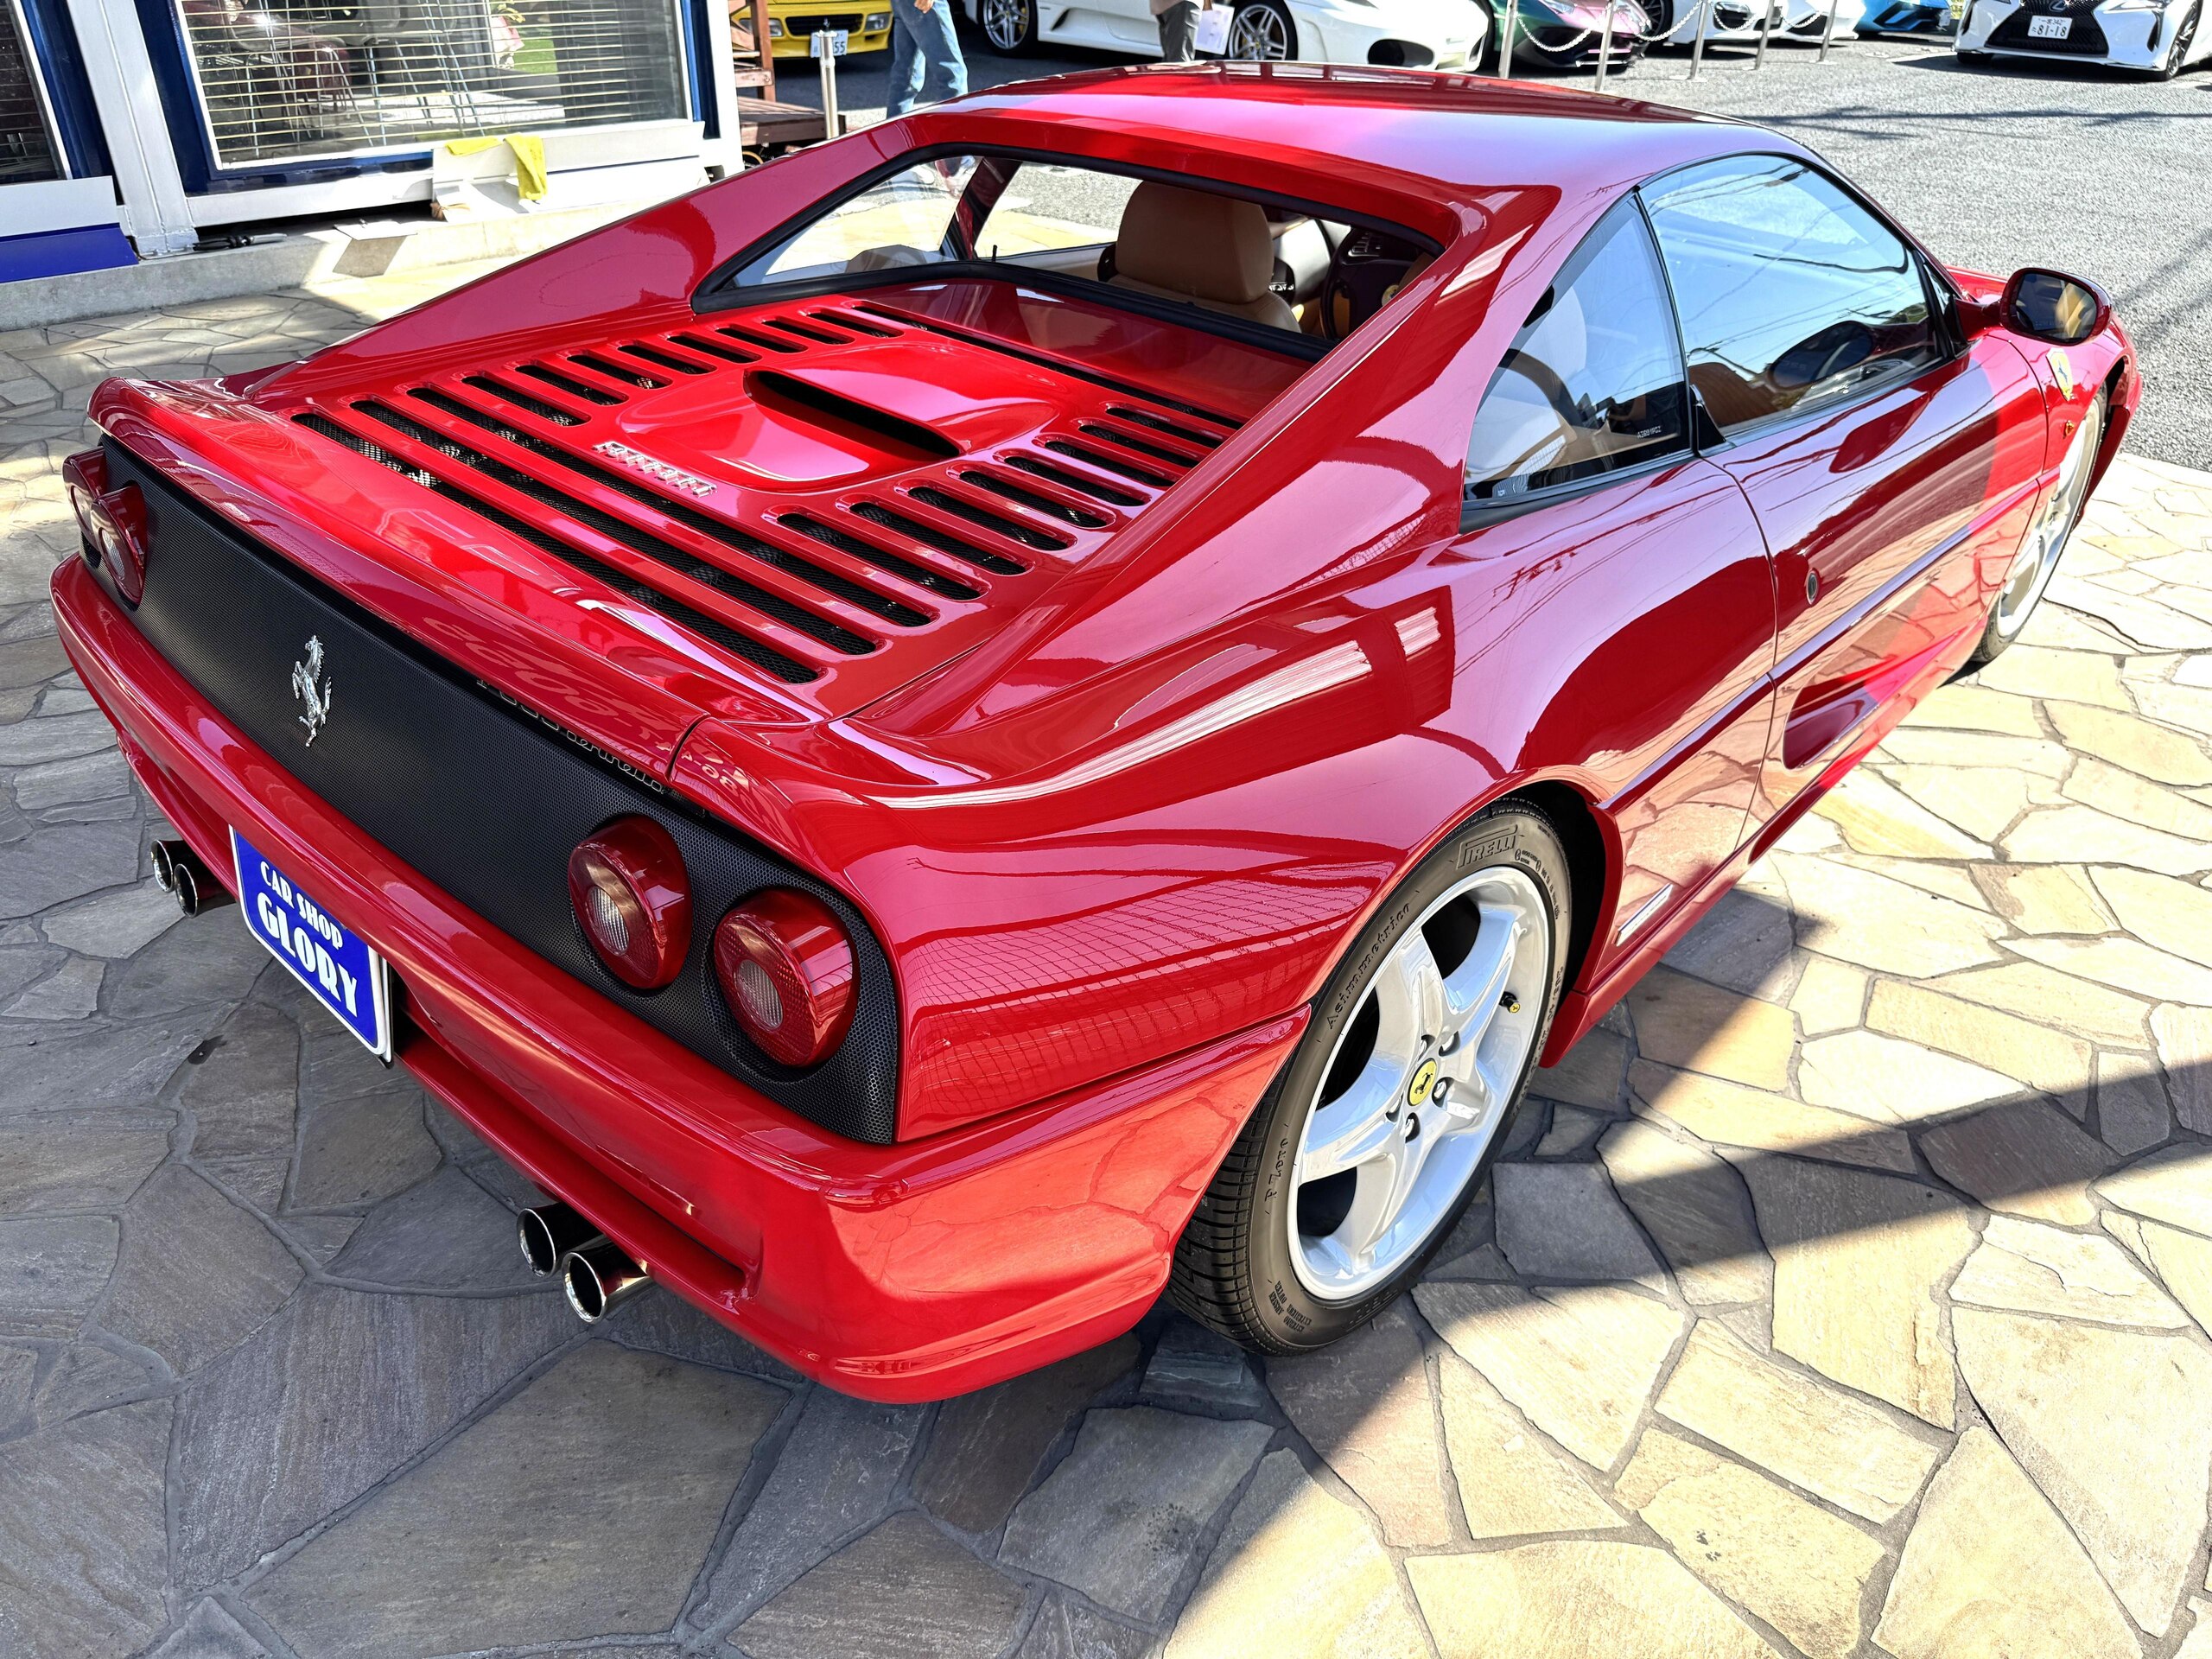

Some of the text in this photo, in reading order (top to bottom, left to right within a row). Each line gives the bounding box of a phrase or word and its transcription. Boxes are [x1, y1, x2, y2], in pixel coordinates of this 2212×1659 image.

[1456, 824, 1518, 870] PIRELLI
[260, 860, 344, 950] CAR SHOP
[257, 891, 359, 1018] GLORY
